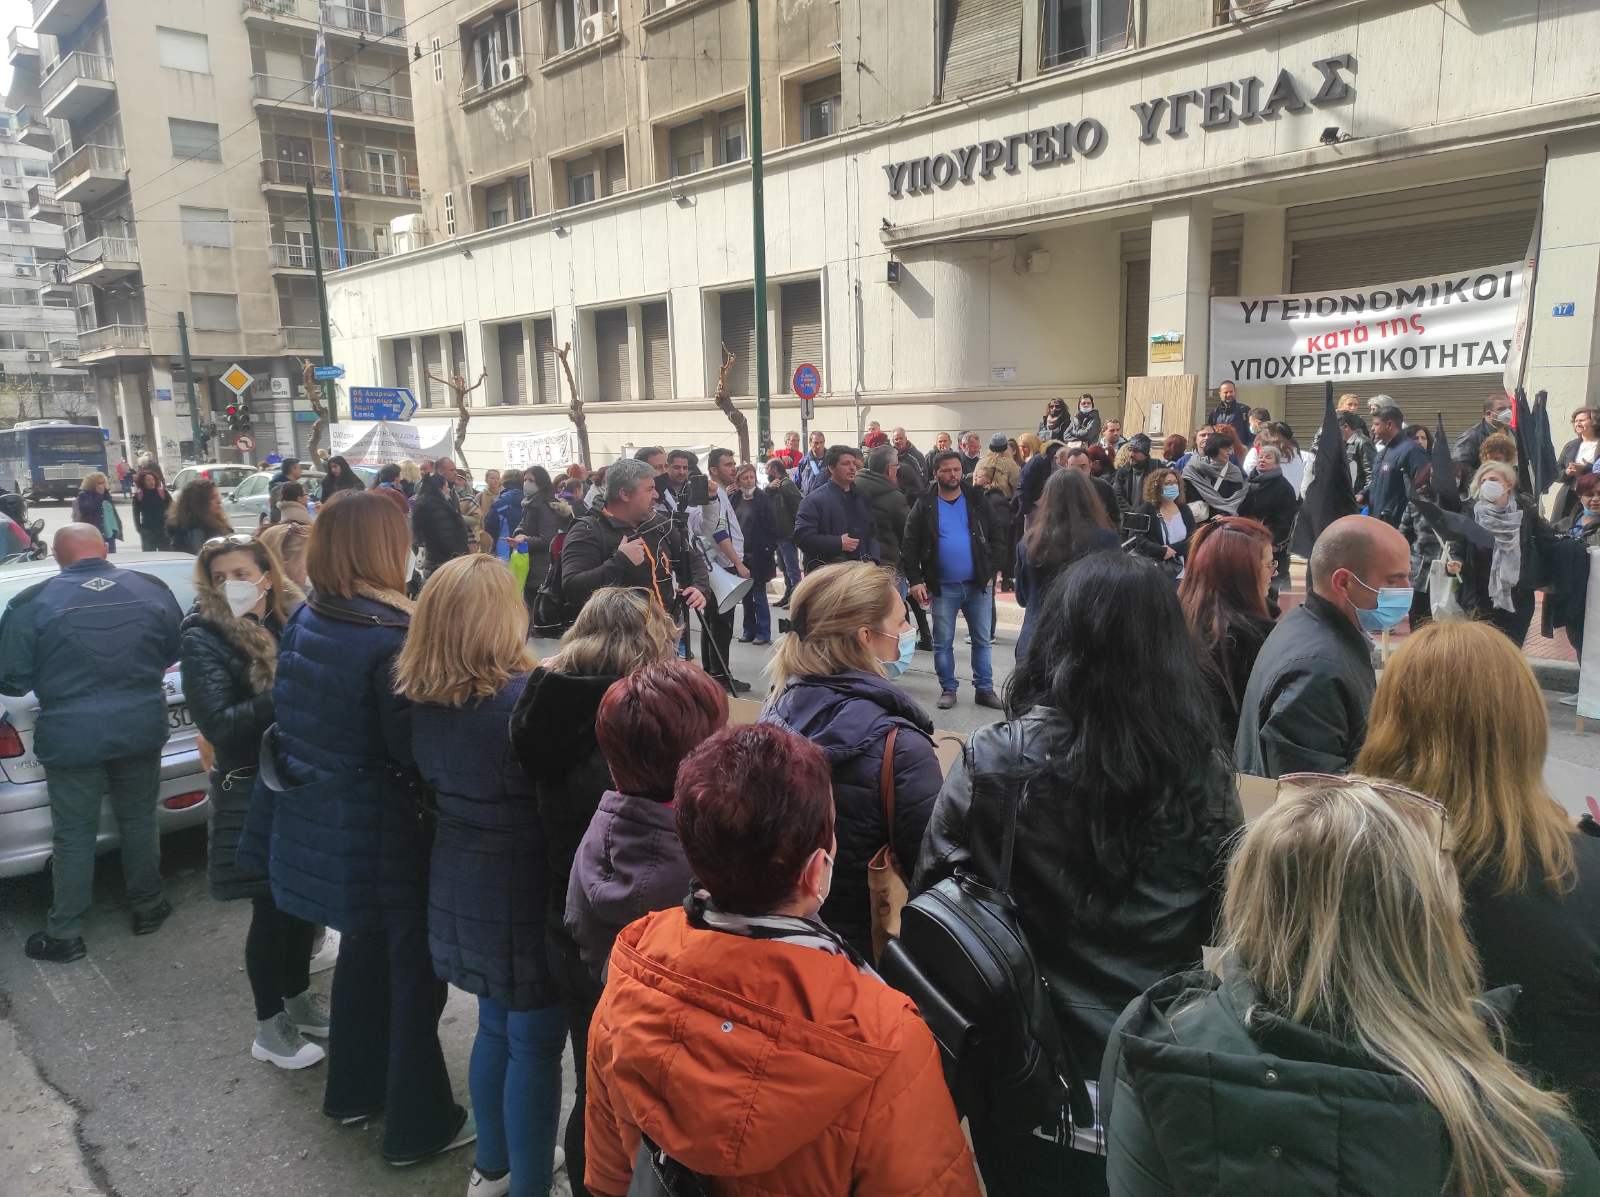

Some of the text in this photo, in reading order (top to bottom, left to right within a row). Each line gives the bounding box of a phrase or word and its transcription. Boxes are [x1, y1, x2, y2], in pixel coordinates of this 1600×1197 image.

[882, 53, 1358, 199] ΥΠΟΥΡΓΕΙΟ ΥΓΕΙΑΣ
[1240, 270, 1513, 324] ΥΓΕΙΟΝΟΜΙΚΟΙ
[1307, 313, 1425, 354] κατά της
[1230, 339, 1513, 381] ΥΠΟΧΡΕΩΤΙΚΟΤΗΤΑΣ
